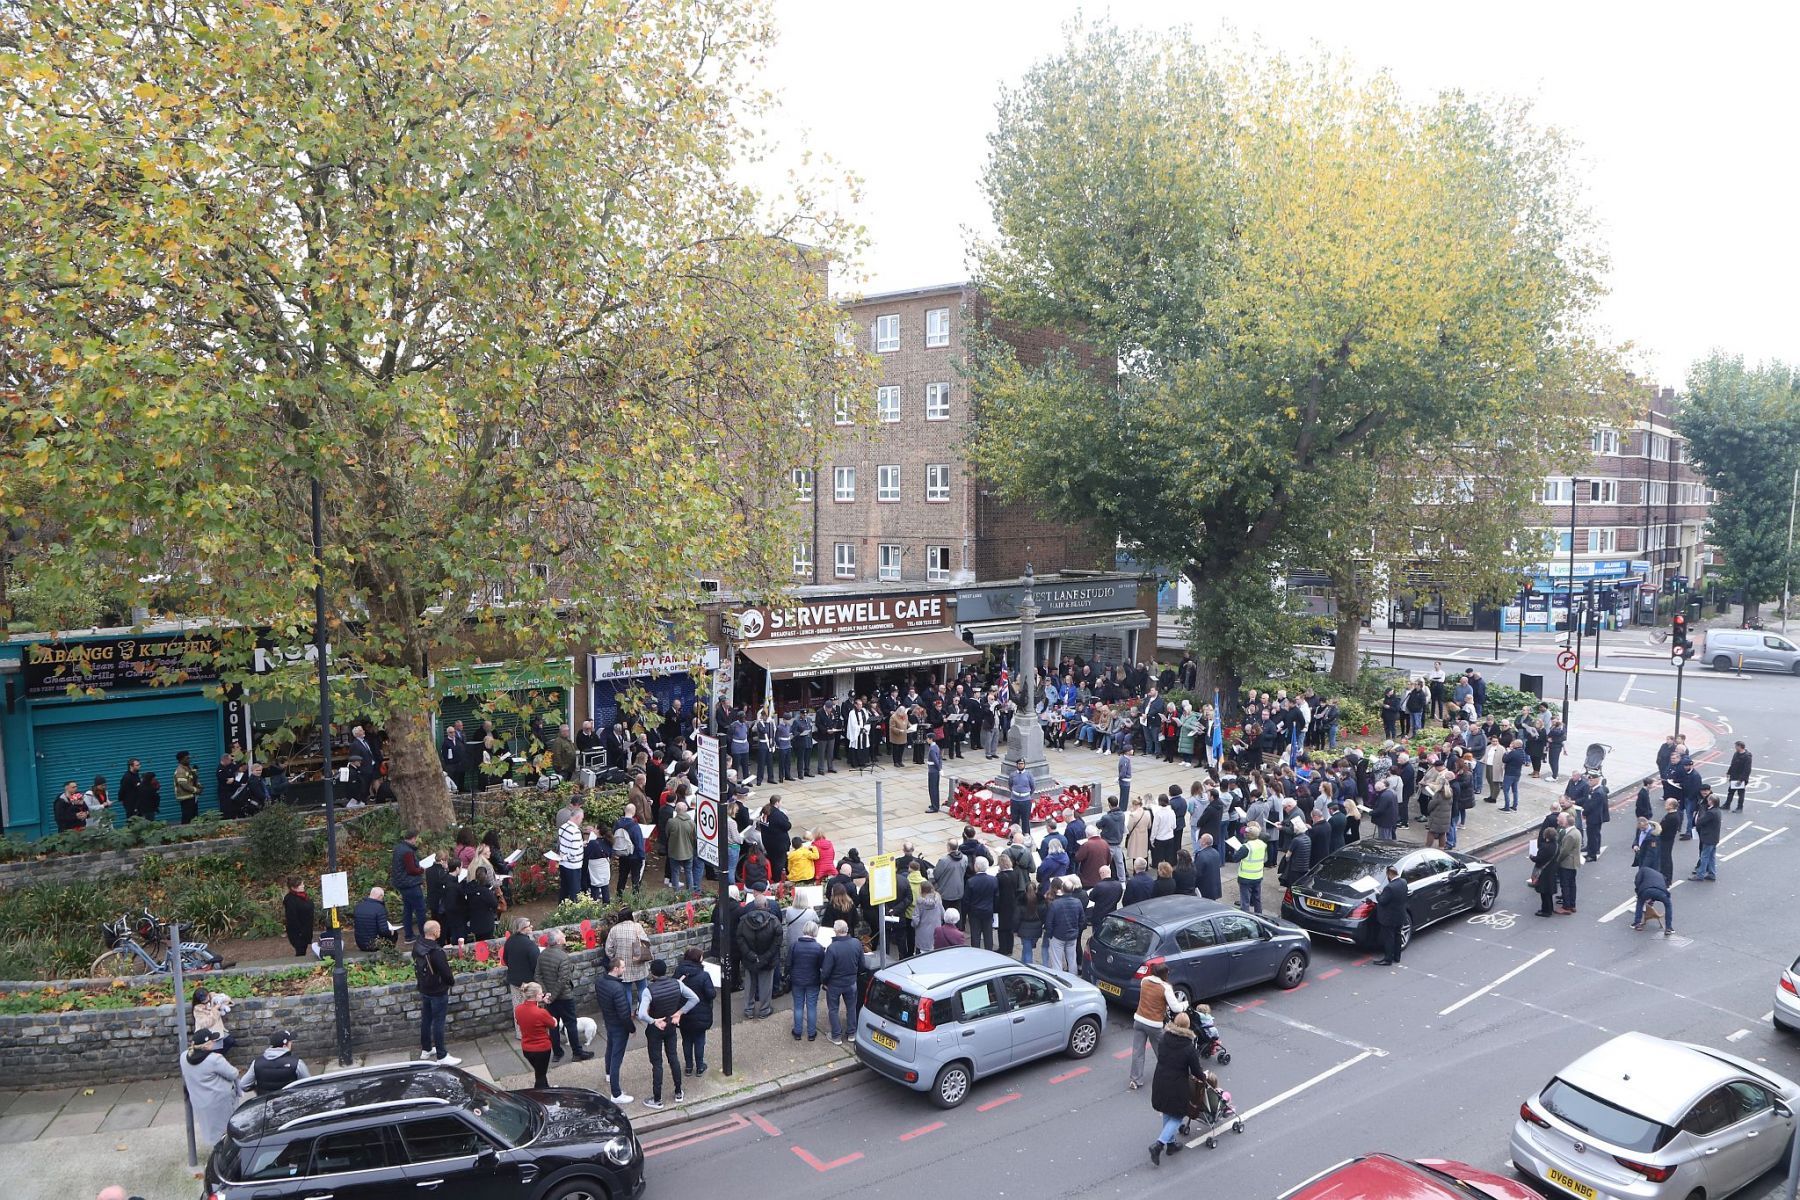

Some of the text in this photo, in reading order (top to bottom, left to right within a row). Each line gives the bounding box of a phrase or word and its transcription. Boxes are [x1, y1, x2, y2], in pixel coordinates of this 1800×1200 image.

[1054, 589, 1080, 600] LANE
[1080, 587, 1115, 599] STUDIO
[1070, 600, 1092, 608] BEAUTY
[771, 601, 890, 628] SERVEWELL
[895, 599, 941, 619] CAFE
[810, 641, 924, 664] SERVEWELL CAFE
[701, 811, 715, 830] 30
[1551, 1169, 1593, 1198] DV68 NBG
